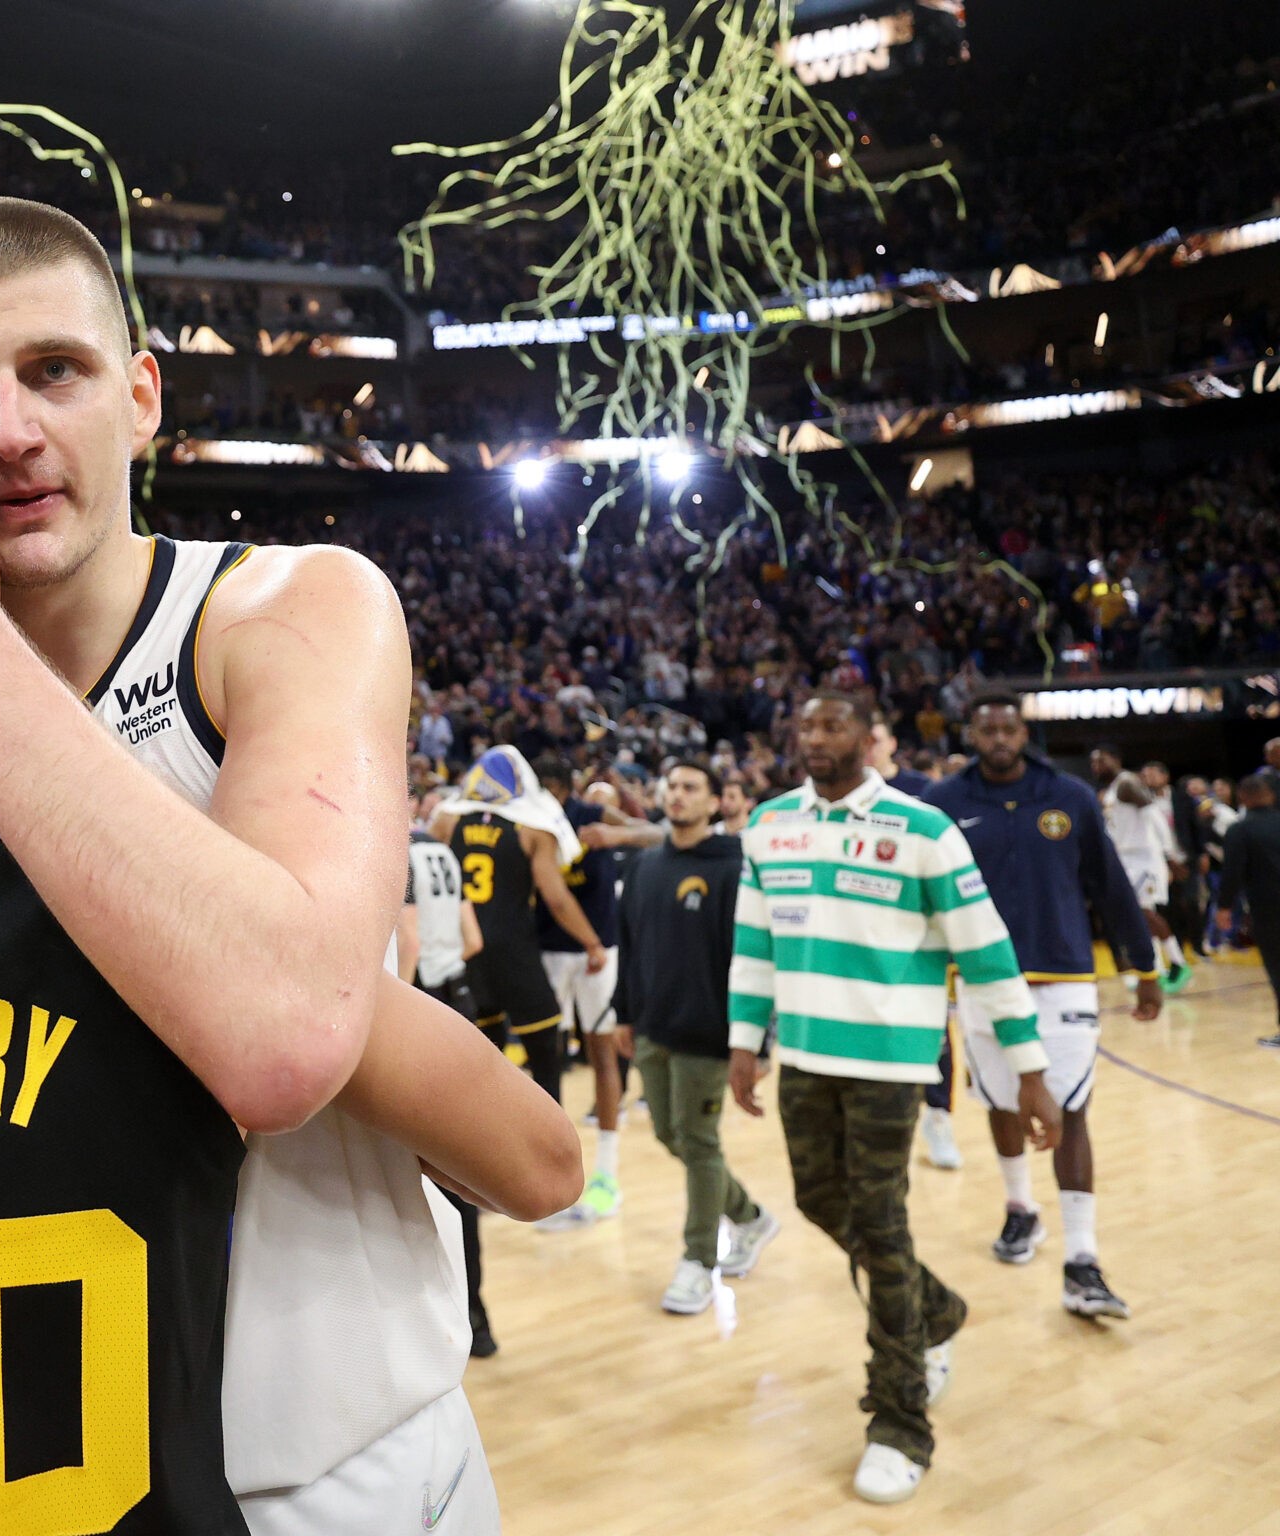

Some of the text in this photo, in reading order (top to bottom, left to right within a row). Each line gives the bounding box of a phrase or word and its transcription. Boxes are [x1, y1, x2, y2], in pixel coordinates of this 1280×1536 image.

[114, 661, 174, 715] WU
[116, 698, 177, 735] Western
[128, 717, 172, 745] Union
[463, 852, 495, 904] 3
